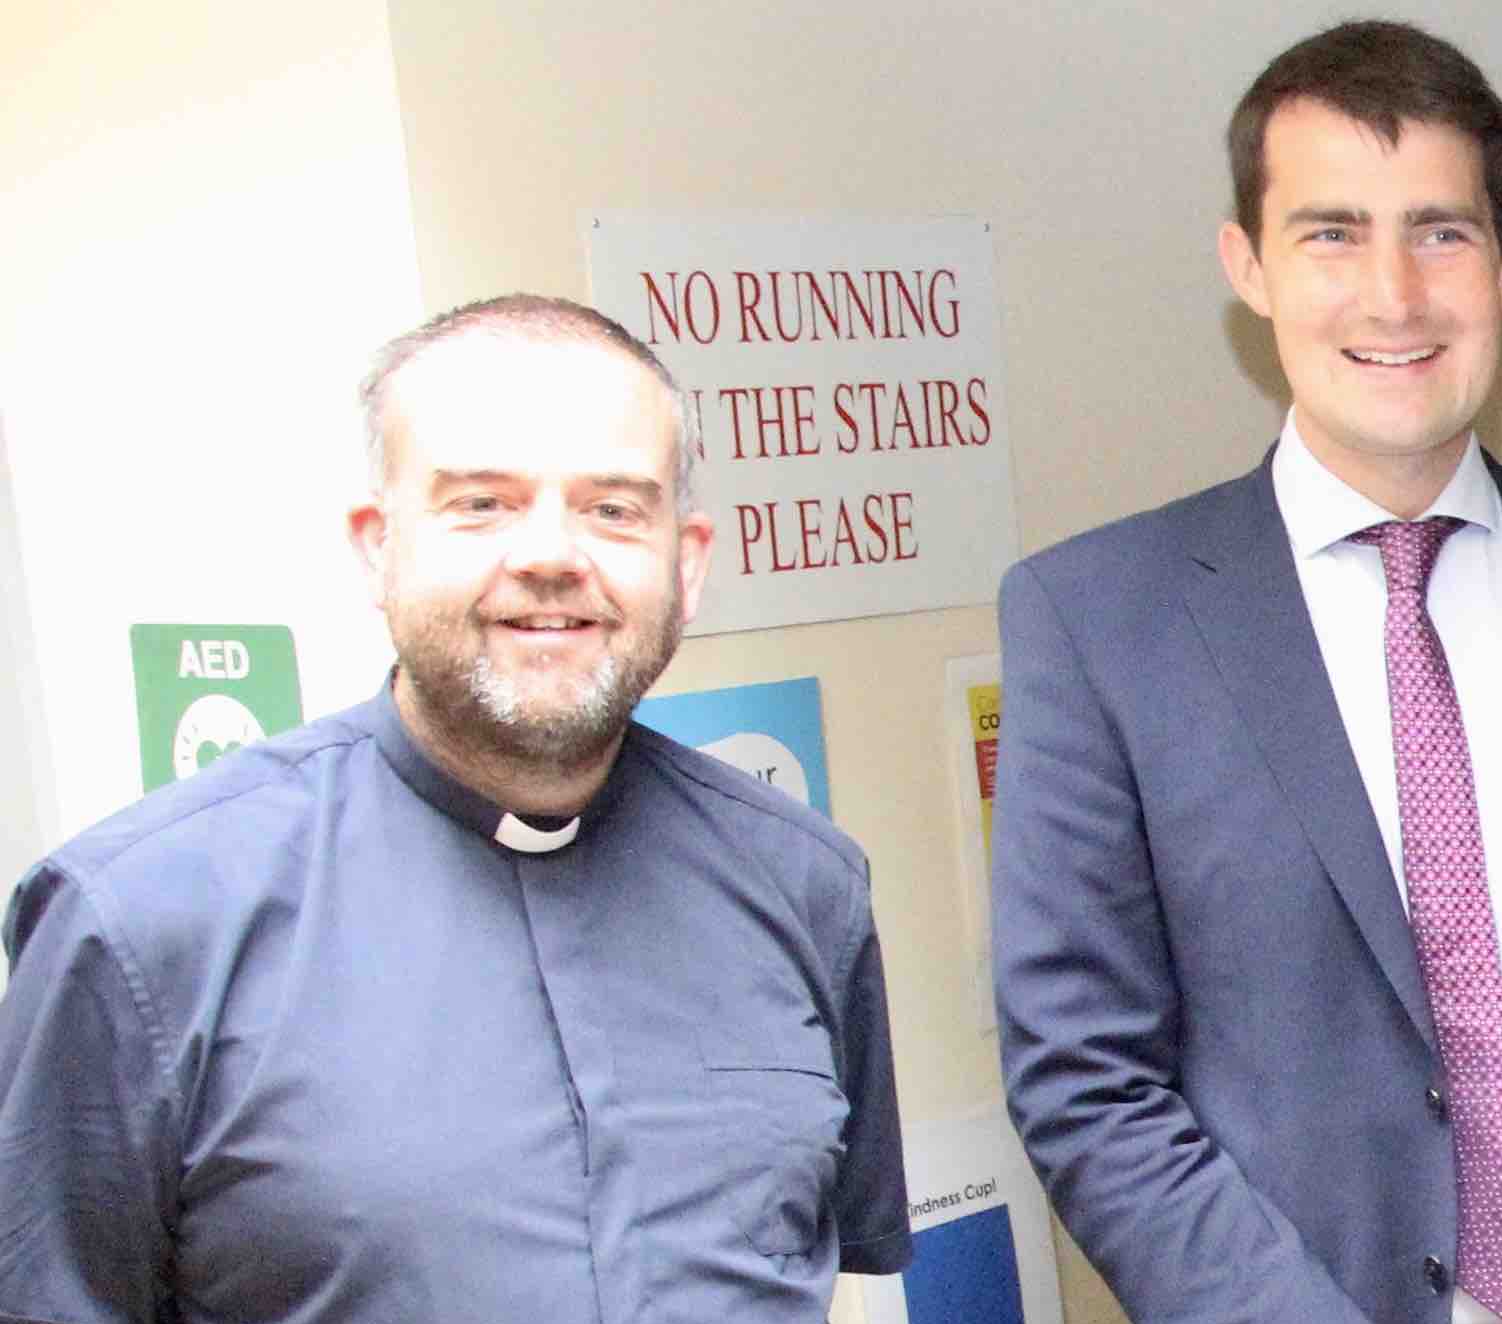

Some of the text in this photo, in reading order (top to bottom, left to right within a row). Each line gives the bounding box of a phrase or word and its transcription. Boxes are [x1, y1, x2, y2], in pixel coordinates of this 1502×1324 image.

[639, 269, 960, 345] NO RUNNING
[718, 384, 820, 460] THE
[833, 377, 992, 455] STAIRS
[734, 492, 919, 575] PLEASE
[178, 640, 251, 679] AED
[909, 1193, 961, 1216] indness
